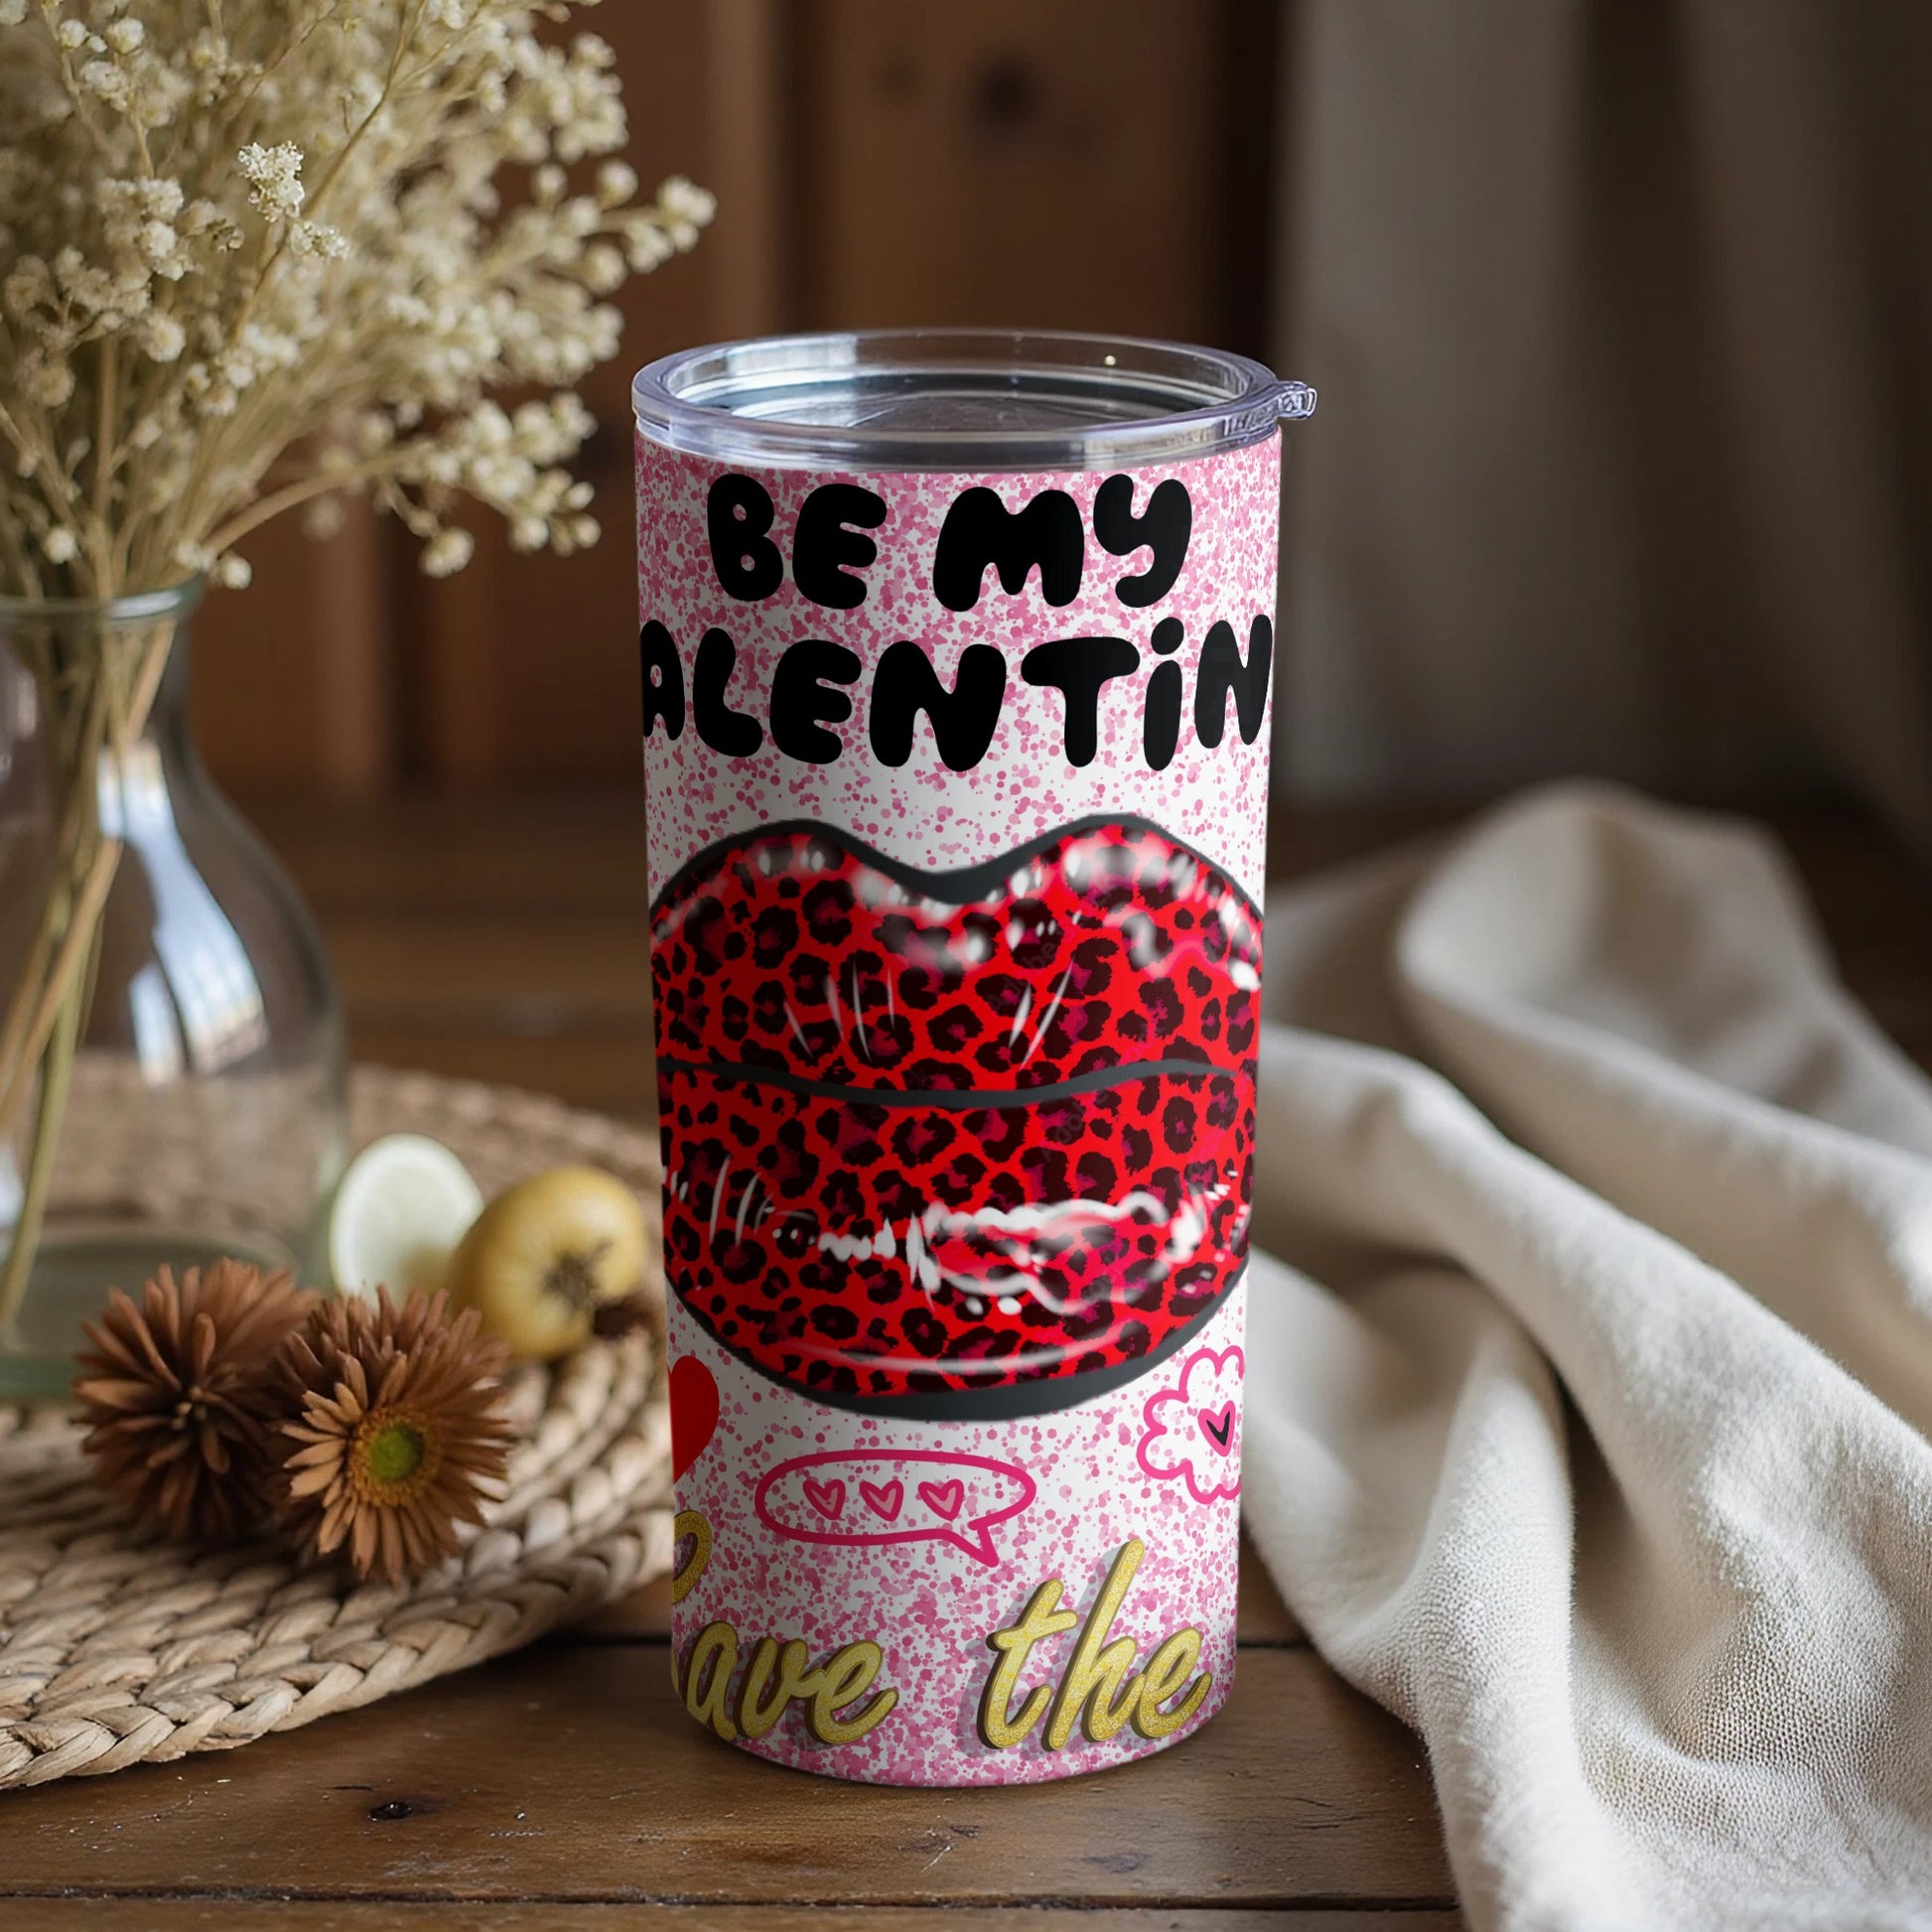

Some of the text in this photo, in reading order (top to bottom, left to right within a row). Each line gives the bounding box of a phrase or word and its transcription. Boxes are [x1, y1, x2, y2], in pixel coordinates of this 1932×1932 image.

[707, 474, 1192, 613] BE MY
[671, 1539, 1212, 1751] ave the
